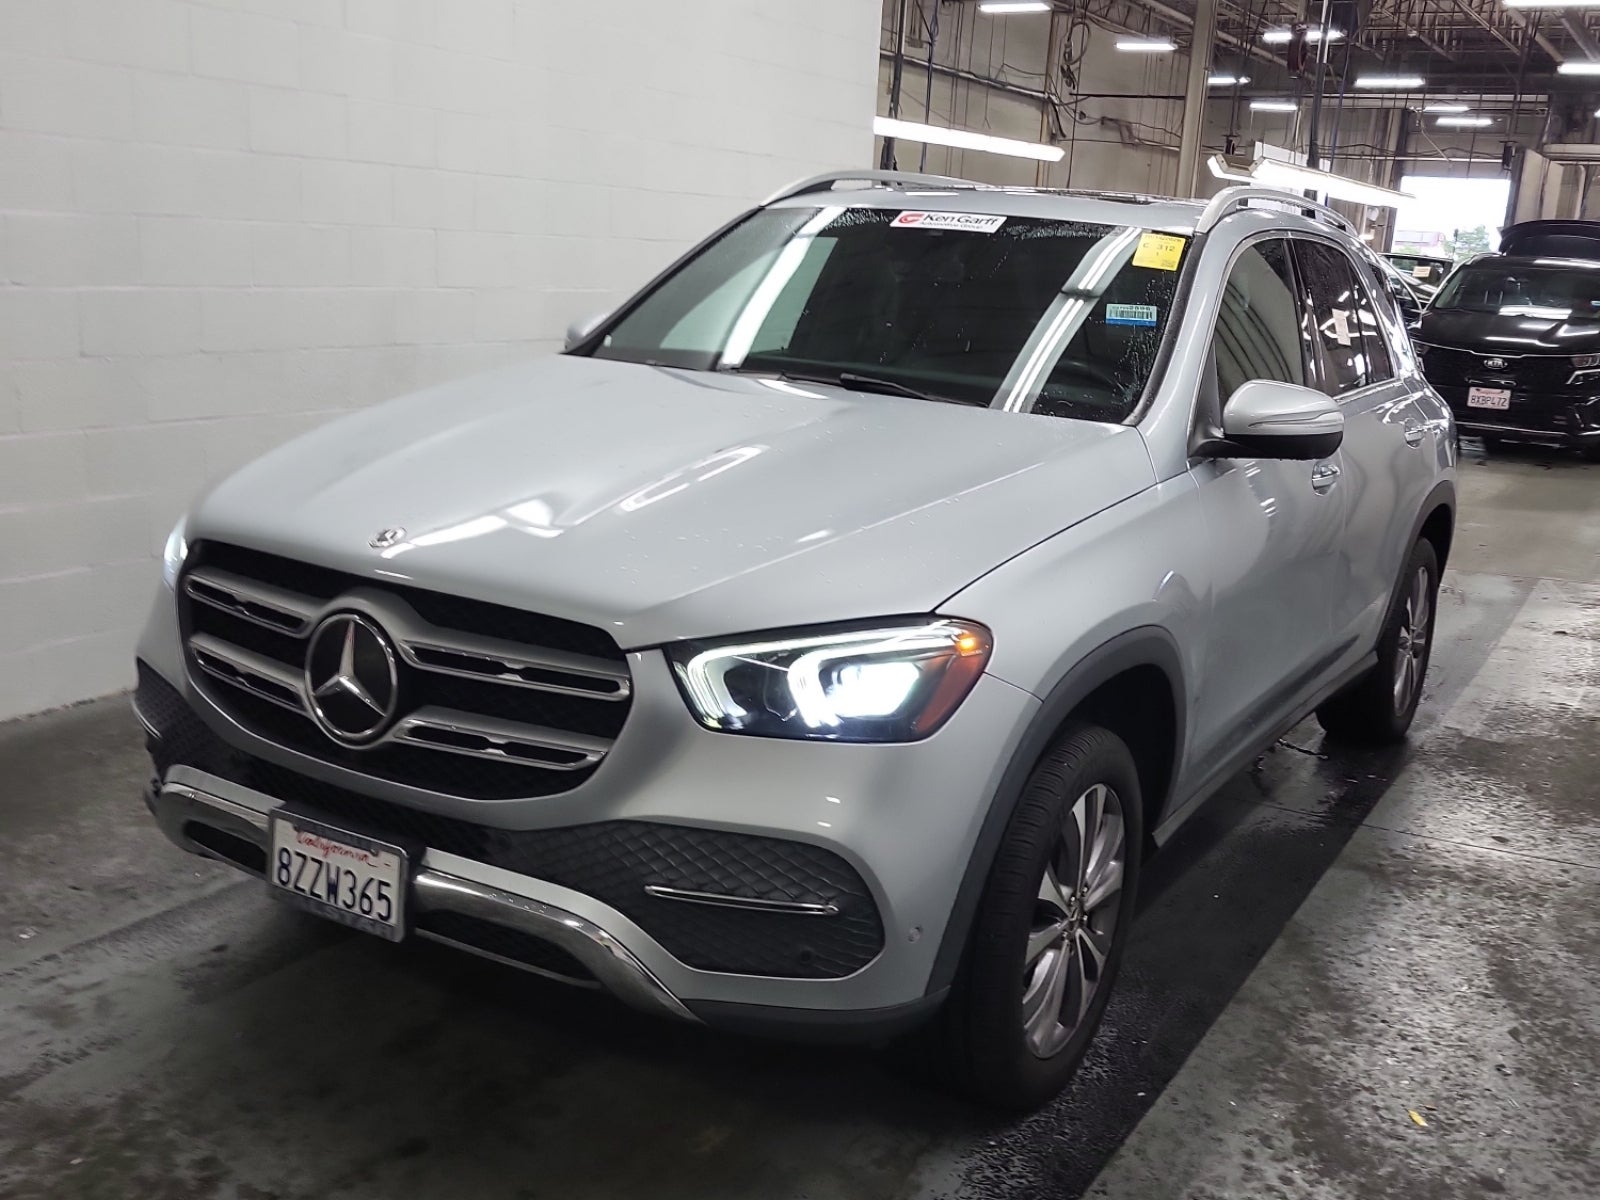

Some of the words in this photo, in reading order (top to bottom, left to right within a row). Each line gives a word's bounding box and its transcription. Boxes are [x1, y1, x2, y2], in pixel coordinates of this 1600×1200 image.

[923, 213, 955, 222] Ken
[955, 215, 998, 226] Garff
[295, 830, 378, 868] California
[277, 847, 392, 922] 8ZZW365
